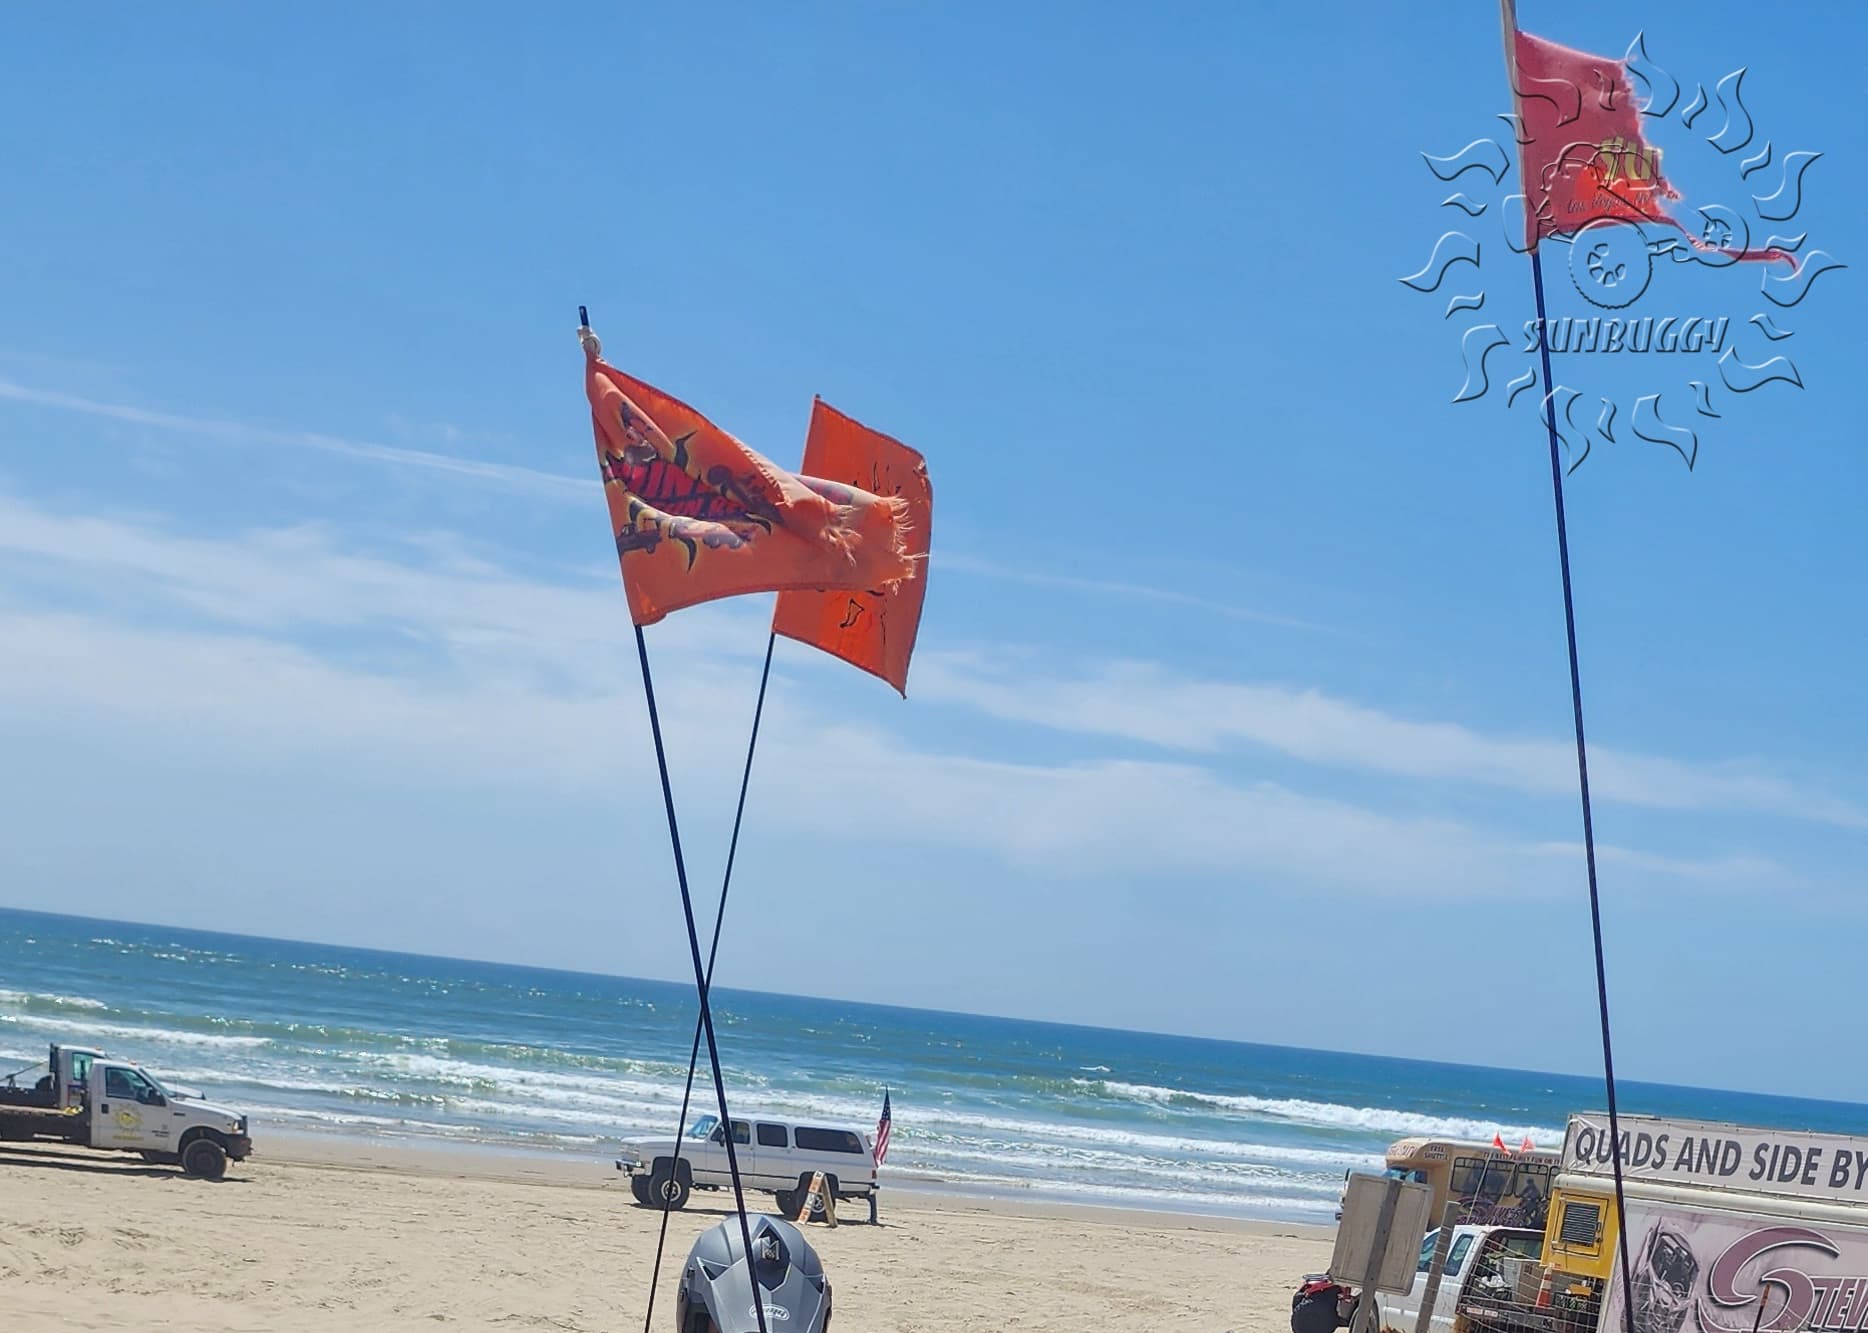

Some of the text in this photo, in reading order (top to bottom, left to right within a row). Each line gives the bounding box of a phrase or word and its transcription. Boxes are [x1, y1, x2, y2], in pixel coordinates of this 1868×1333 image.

[1575, 1126, 1868, 1190] QUADS AND SIDE BY
